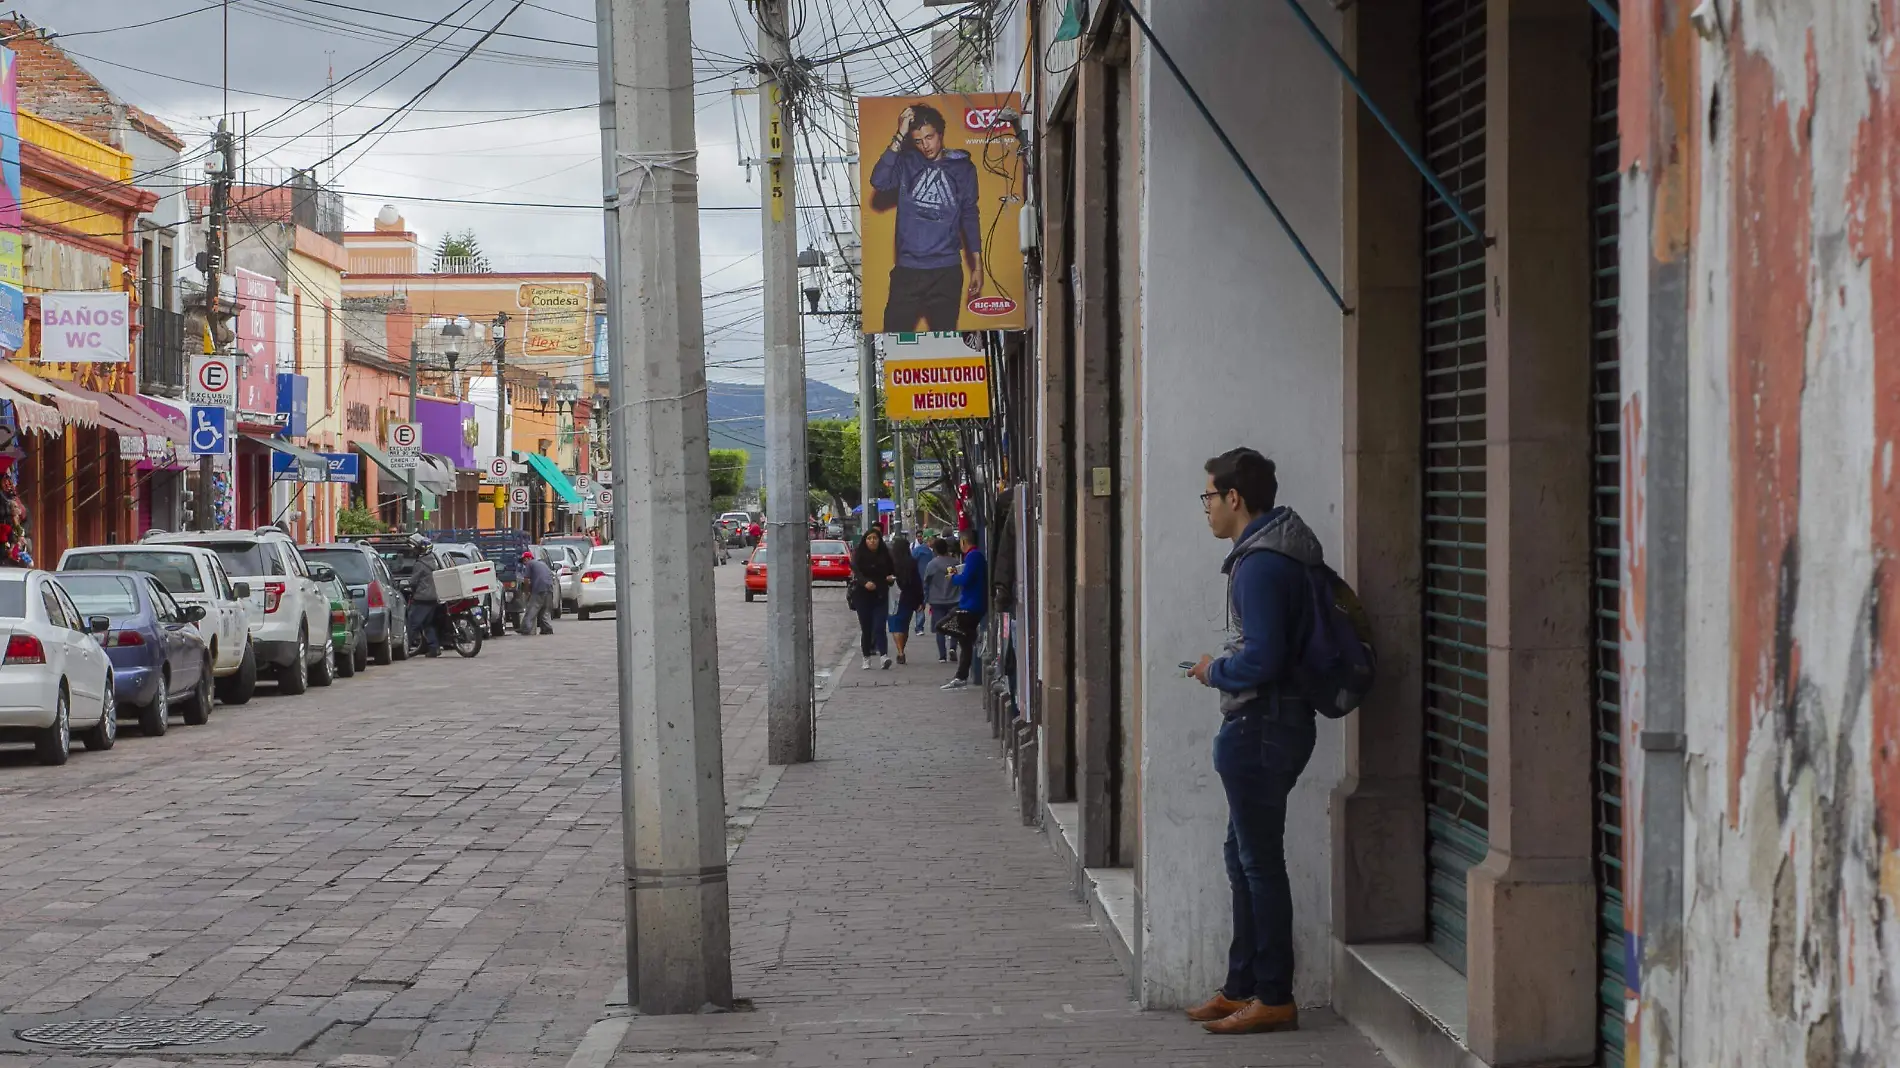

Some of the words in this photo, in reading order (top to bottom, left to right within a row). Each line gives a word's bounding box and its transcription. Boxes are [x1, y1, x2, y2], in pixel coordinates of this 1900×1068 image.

[532, 296, 579, 306] Condesa
[44, 305, 124, 326] BAÑOS
[65, 331, 102, 348] WC
[207, 367, 221, 385] E
[892, 365, 986, 386] CONSULTORIO
[912, 390, 968, 411] MÉDICO
[400, 429, 409, 441] E
